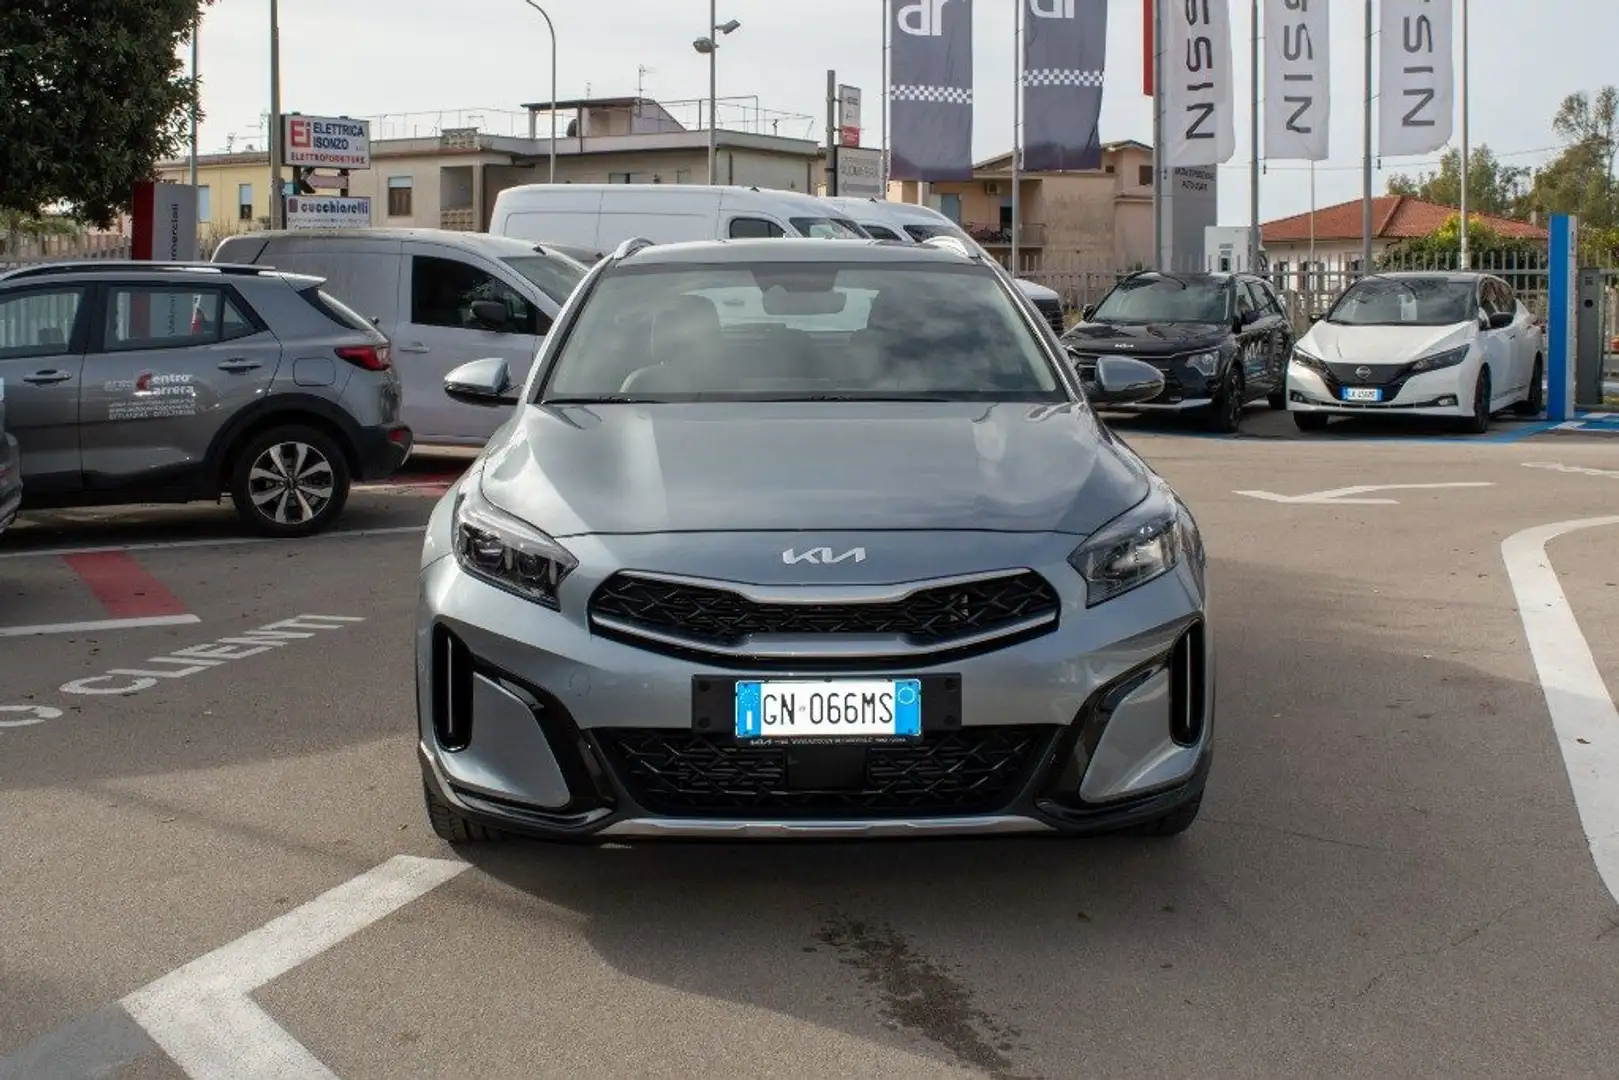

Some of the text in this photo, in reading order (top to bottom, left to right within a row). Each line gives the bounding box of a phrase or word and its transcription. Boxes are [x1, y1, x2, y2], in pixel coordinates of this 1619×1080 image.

[313, 121, 365, 137] ELETTRICA
[313, 136, 349, 150] ISONZO
[301, 200, 369, 214] cucchiarelli
[782, 547, 867, 564] KIA
[58, 613, 367, 695] CLIENTI
[763, 693, 795, 725] GN
[809, 692, 893, 724] 066MS
